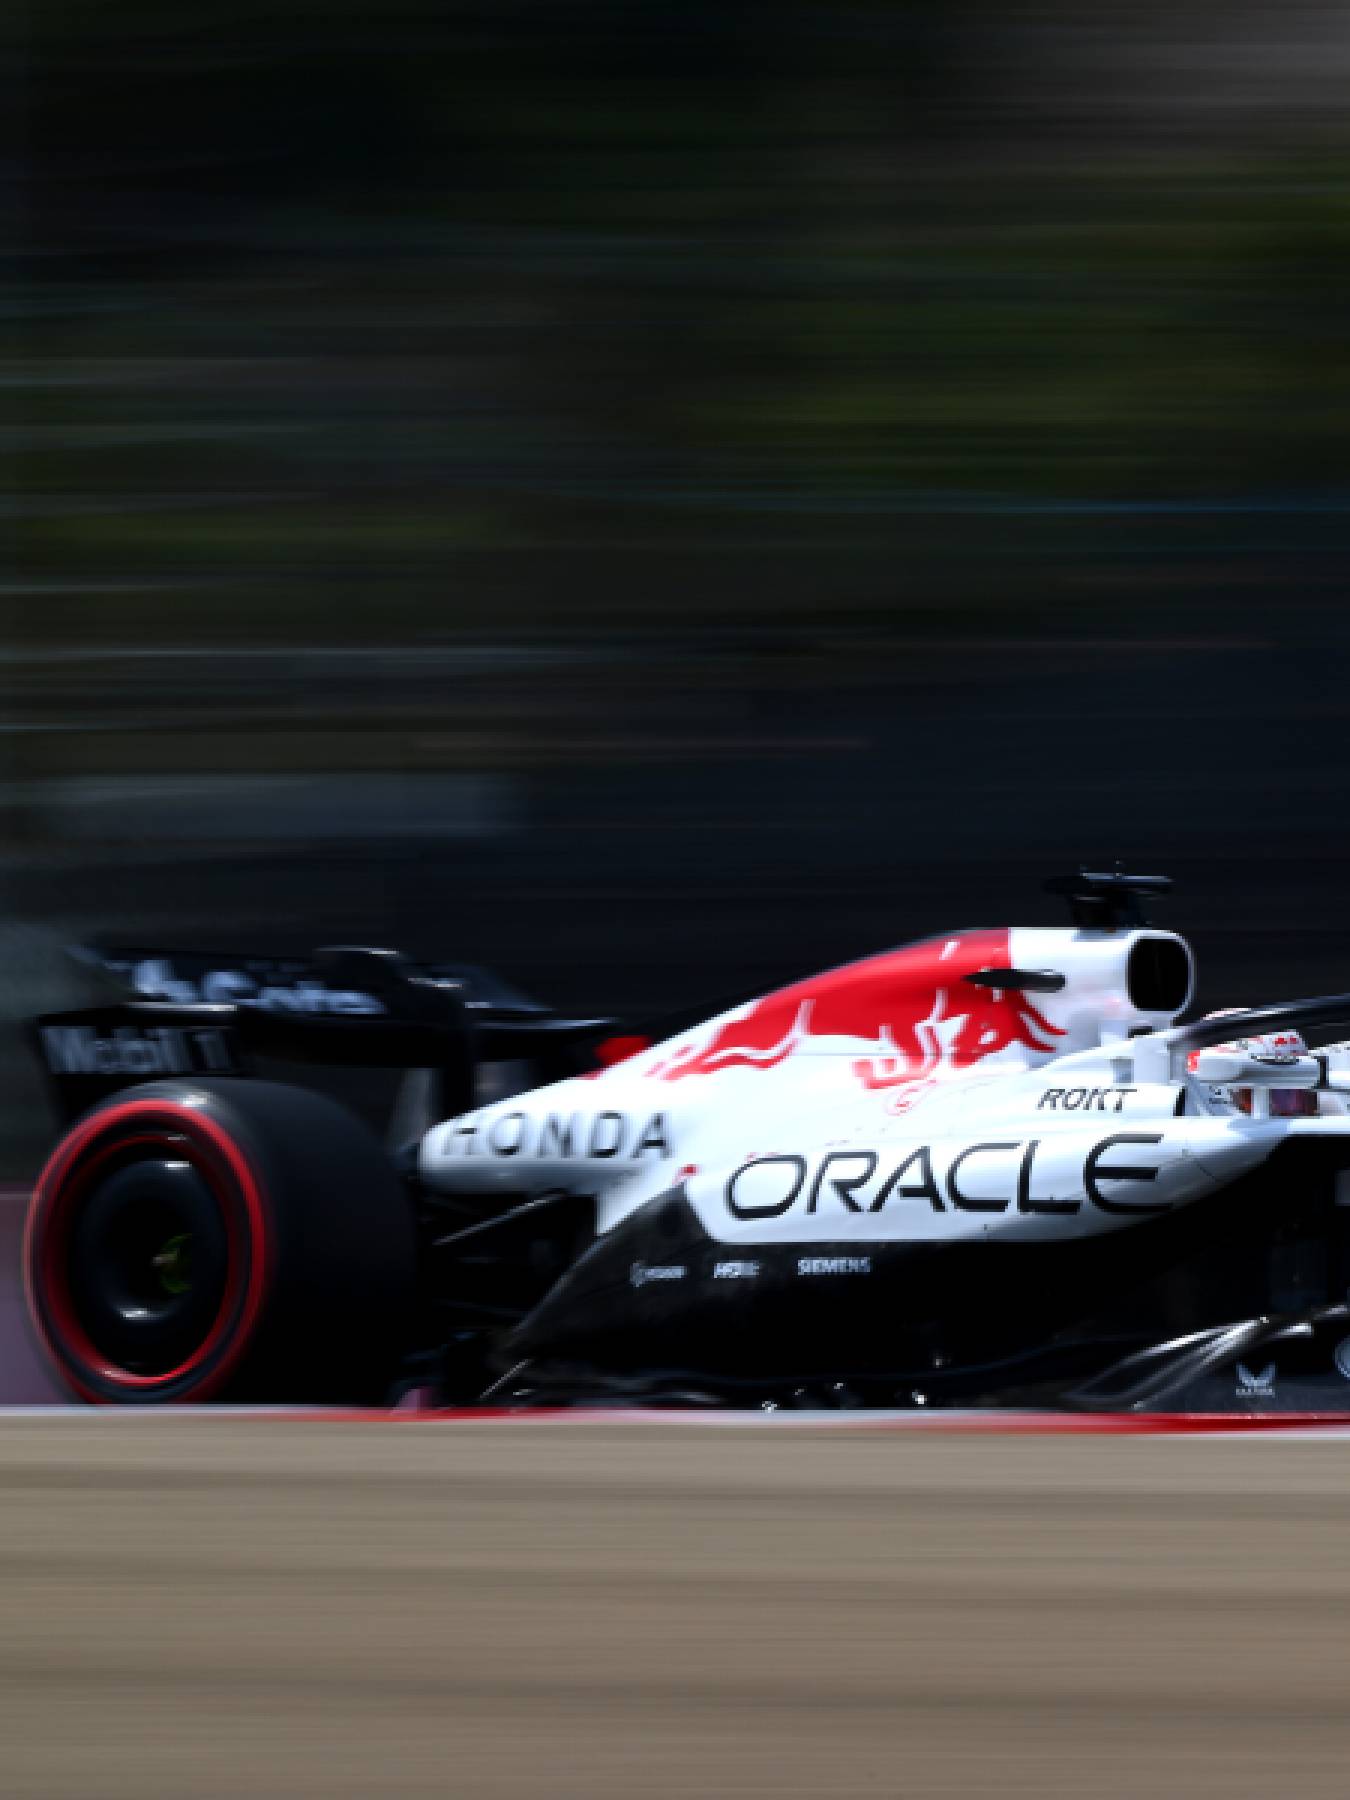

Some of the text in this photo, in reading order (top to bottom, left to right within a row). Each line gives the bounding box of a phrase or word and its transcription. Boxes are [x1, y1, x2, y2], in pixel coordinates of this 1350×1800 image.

[1036, 1088, 1138, 1113] ROKT
[441, 1111, 675, 1160] HONDA
[724, 1133, 1173, 1221] ORACLE
[798, 1256, 871, 1276] SIEMENS
